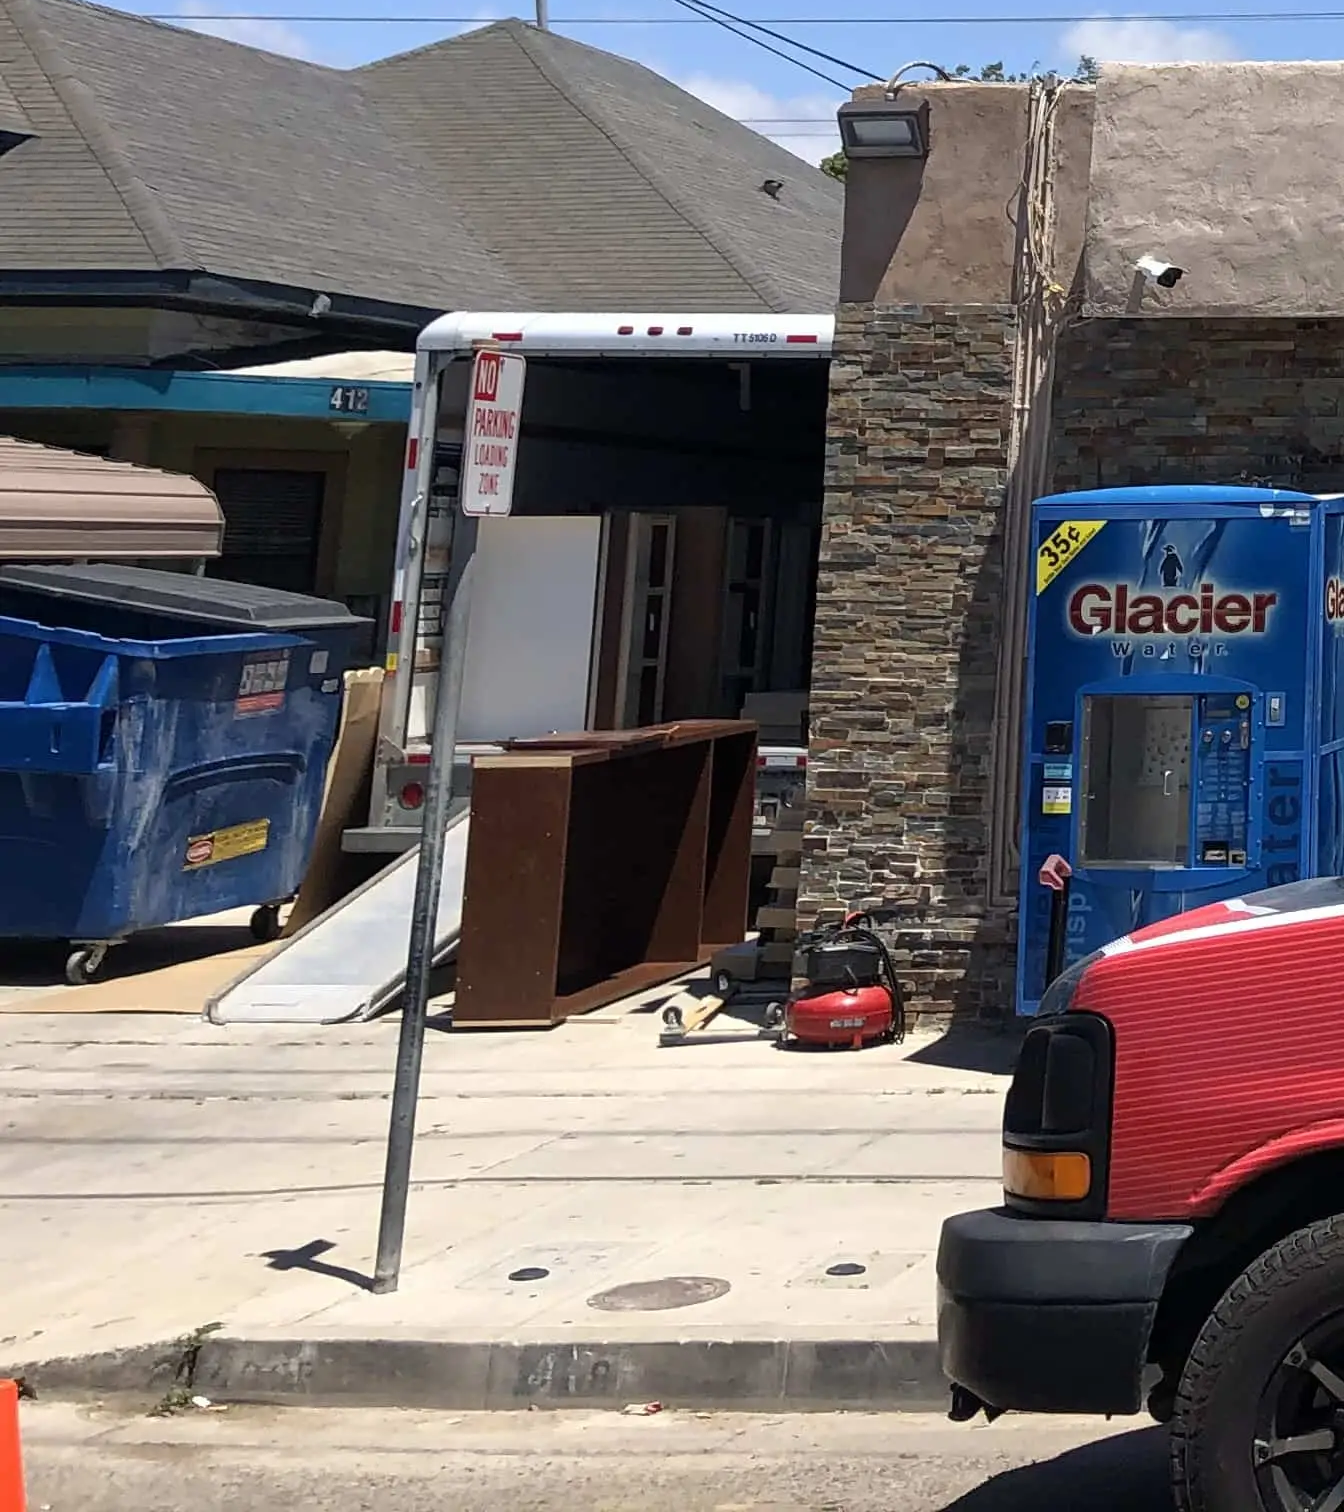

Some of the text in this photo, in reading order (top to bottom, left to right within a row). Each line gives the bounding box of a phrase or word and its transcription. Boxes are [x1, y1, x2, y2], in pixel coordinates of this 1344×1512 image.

[477, 359, 497, 395] NO
[330, 387, 369, 411] 412
[474, 407, 516, 439] PARKING
[474, 443, 508, 468] LOADING
[478, 472, 500, 496] ZONE
[1040, 525, 1081, 567] 35¢
[1069, 583, 1277, 635] Glacier
[1112, 641, 1225, 659] Water
